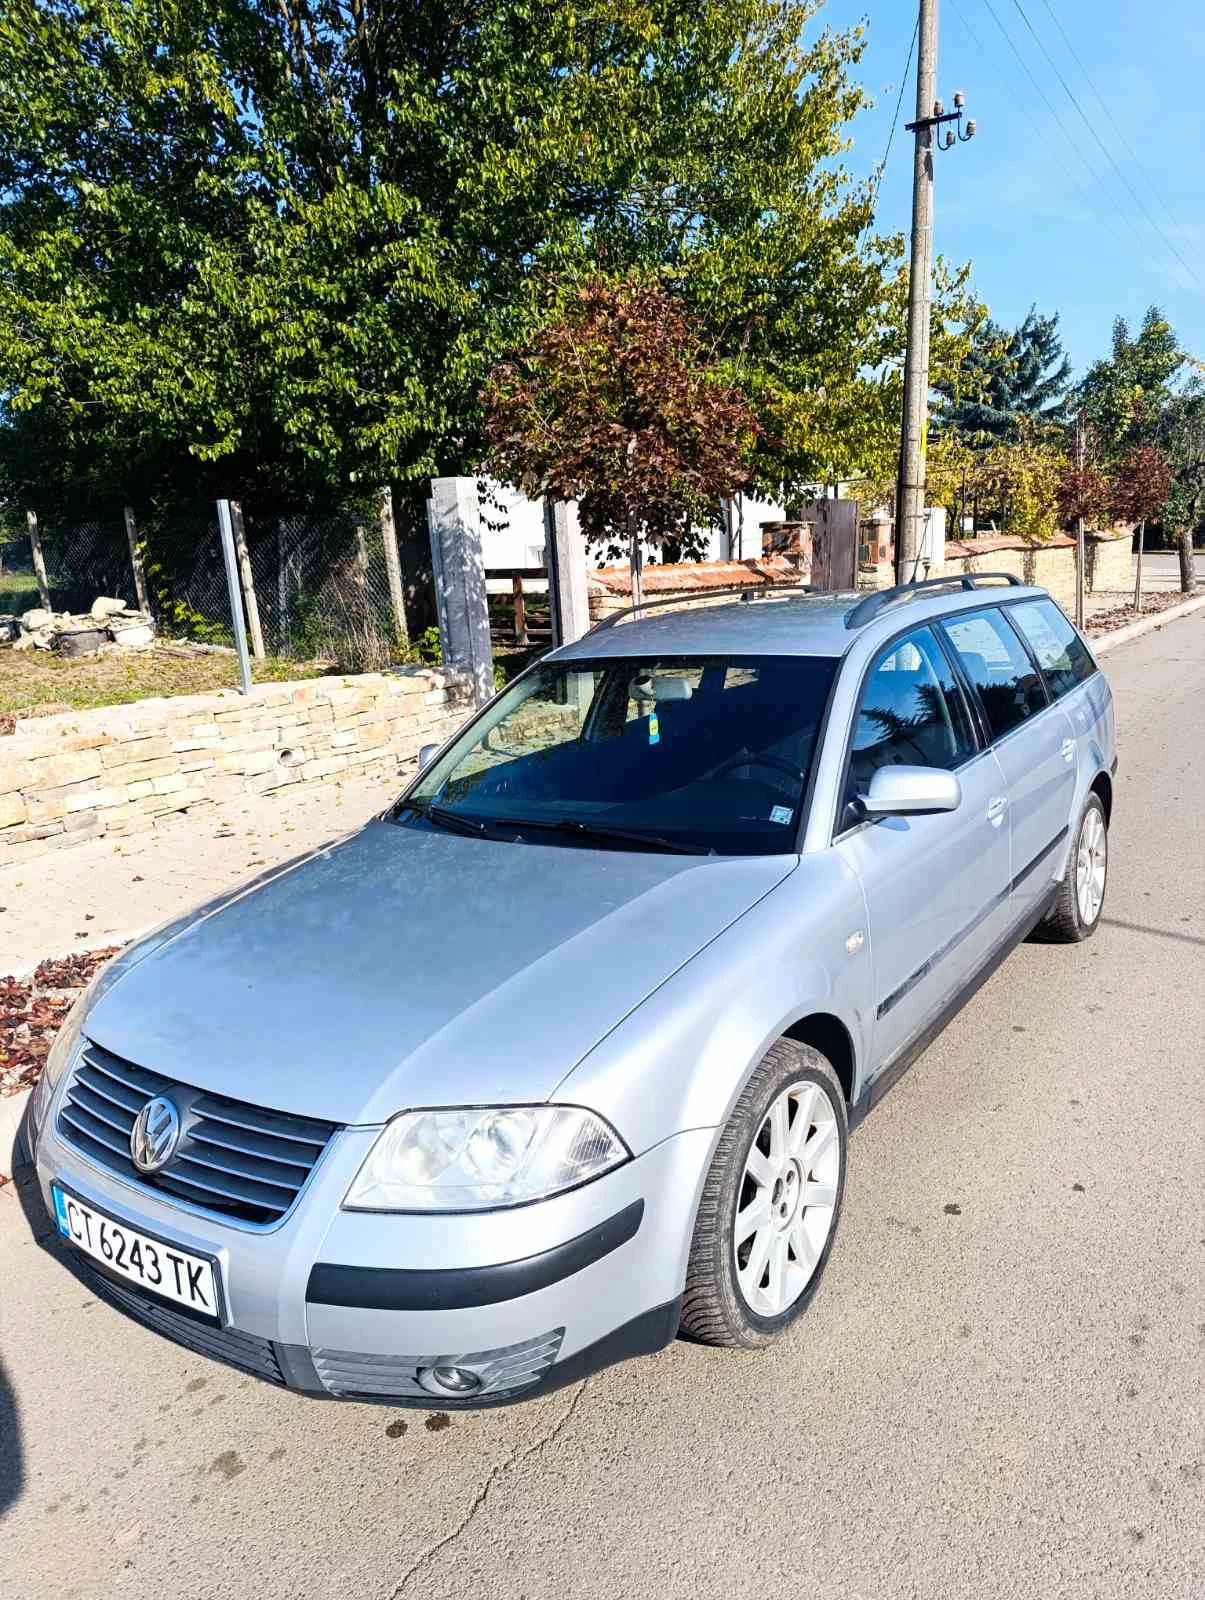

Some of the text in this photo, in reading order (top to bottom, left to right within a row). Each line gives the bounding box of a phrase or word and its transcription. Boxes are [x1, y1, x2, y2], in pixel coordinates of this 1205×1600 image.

[132, 1098, 178, 1171] VW
[67, 1201, 209, 1307] CT 6243 TK
